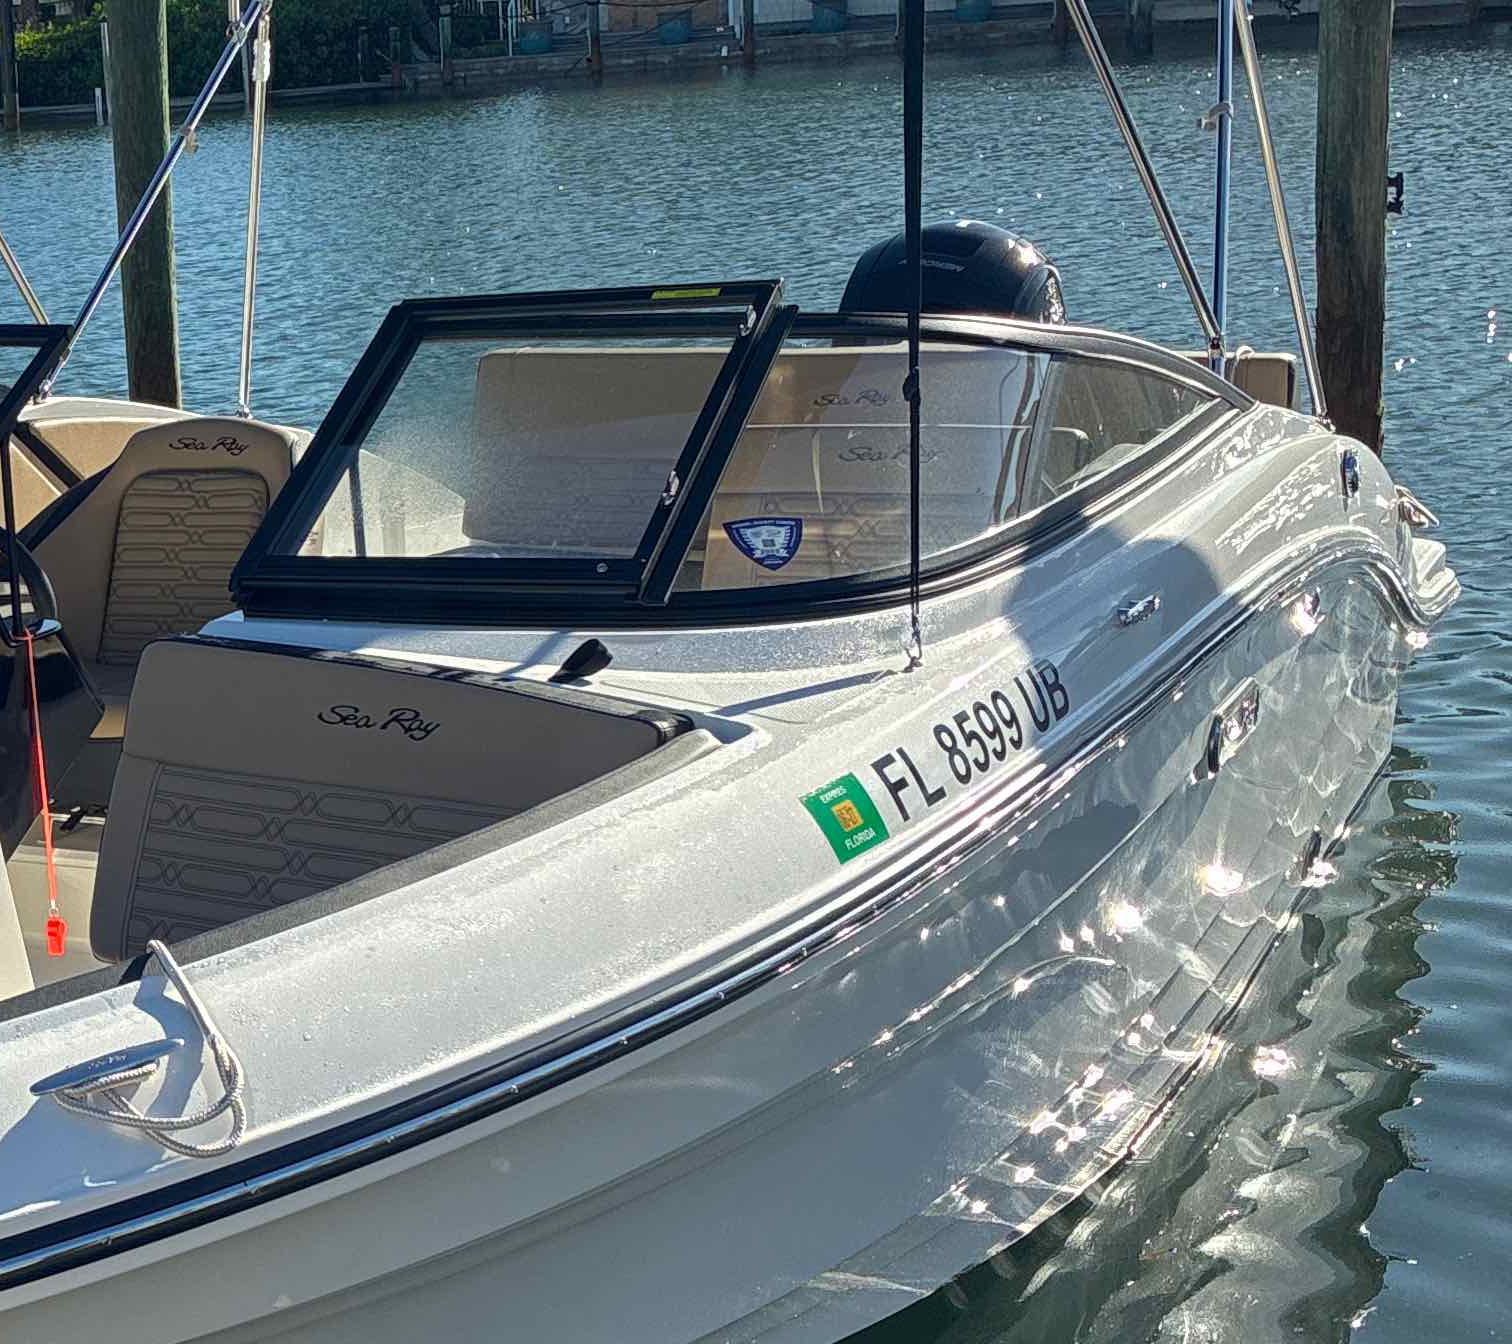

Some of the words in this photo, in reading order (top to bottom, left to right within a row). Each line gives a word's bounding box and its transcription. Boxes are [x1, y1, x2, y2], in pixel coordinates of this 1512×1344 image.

[896, 258, 966, 273] MERCUY
[168, 437, 209, 451] Sea
[210, 436, 250, 456] Ray
[317, 704, 378, 729] Sea
[378, 707, 441, 741] Ray
[870, 746, 948, 823] FL
[932, 689, 1024, 785] 8599
[1013, 658, 1070, 733] UB
[844, 827, 877, 851] FLORIDA
